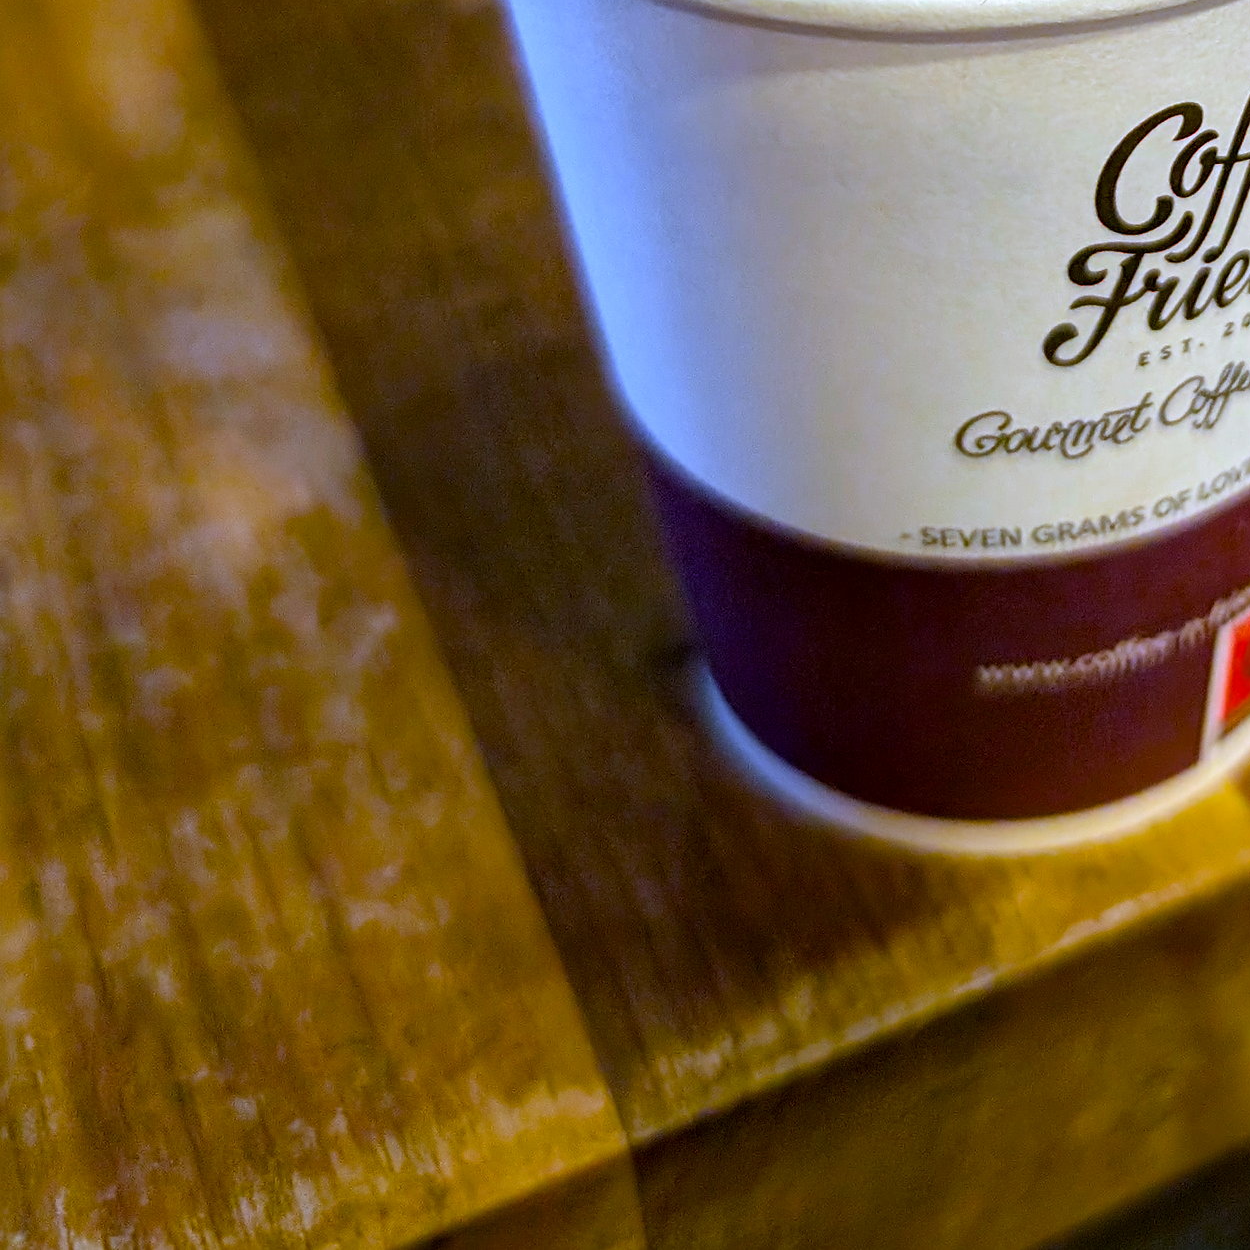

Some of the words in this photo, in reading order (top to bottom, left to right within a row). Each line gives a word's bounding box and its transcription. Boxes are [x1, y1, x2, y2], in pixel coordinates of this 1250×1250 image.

[1137, 336, 1205, 367] EST.
[954, 391, 1154, 460] Gourmet
[920, 525, 1023, 548] SEVEN
[1031, 504, 1147, 545] GRAMS
[1152, 488, 1192, 519] OF
